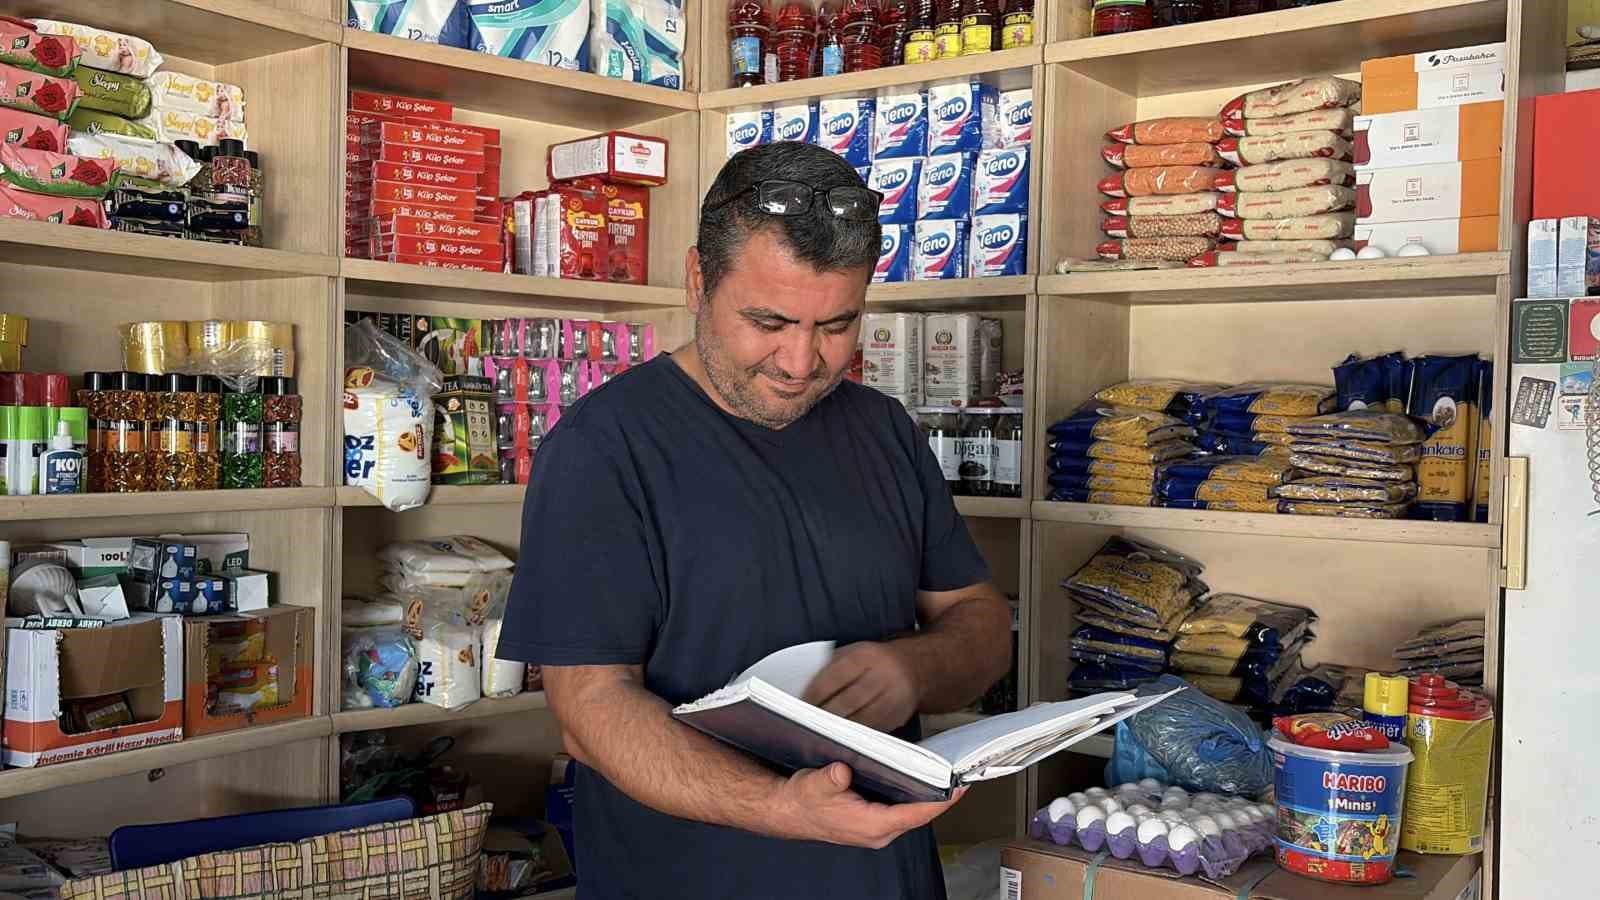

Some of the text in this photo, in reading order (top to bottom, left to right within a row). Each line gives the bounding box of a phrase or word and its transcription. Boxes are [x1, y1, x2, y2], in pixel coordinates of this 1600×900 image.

[488, 1, 520, 13] smart
[408, 28, 422, 41] 12
[14, 38, 26, 47] 90
[547, 50, 562, 67] 12
[90, 71, 120, 92] Sleepy
[396, 101, 435, 113] Küp Şeker
[881, 105, 914, 120] Teno
[936, 101, 965, 121] Teno
[778, 122, 804, 141] Teno
[824, 116, 853, 136] Teno
[425, 133, 466, 145] Küp Şeker
[729, 125, 757, 144] Teno
[425, 152, 465, 165] Küp Şeker
[984, 156, 1018, 176] Teno
[51, 168, 63, 178] 90
[416, 171, 458, 184] Küp Şeker
[876, 170, 906, 189] Teno
[927, 166, 955, 186] Teno
[416, 190, 458, 202] Küp Şeker
[414, 209, 432, 219] Küp
[439, 225, 481, 237] Küp Şeker
[979, 229, 1011, 248] Teno
[440, 244, 482, 256] Küp Şeker
[919, 236, 946, 255] Teno
[227, 557, 242, 567] LED
[46, 619, 103, 628] DERBY DERBY
[1322, 771, 1386, 793] HARIBO
